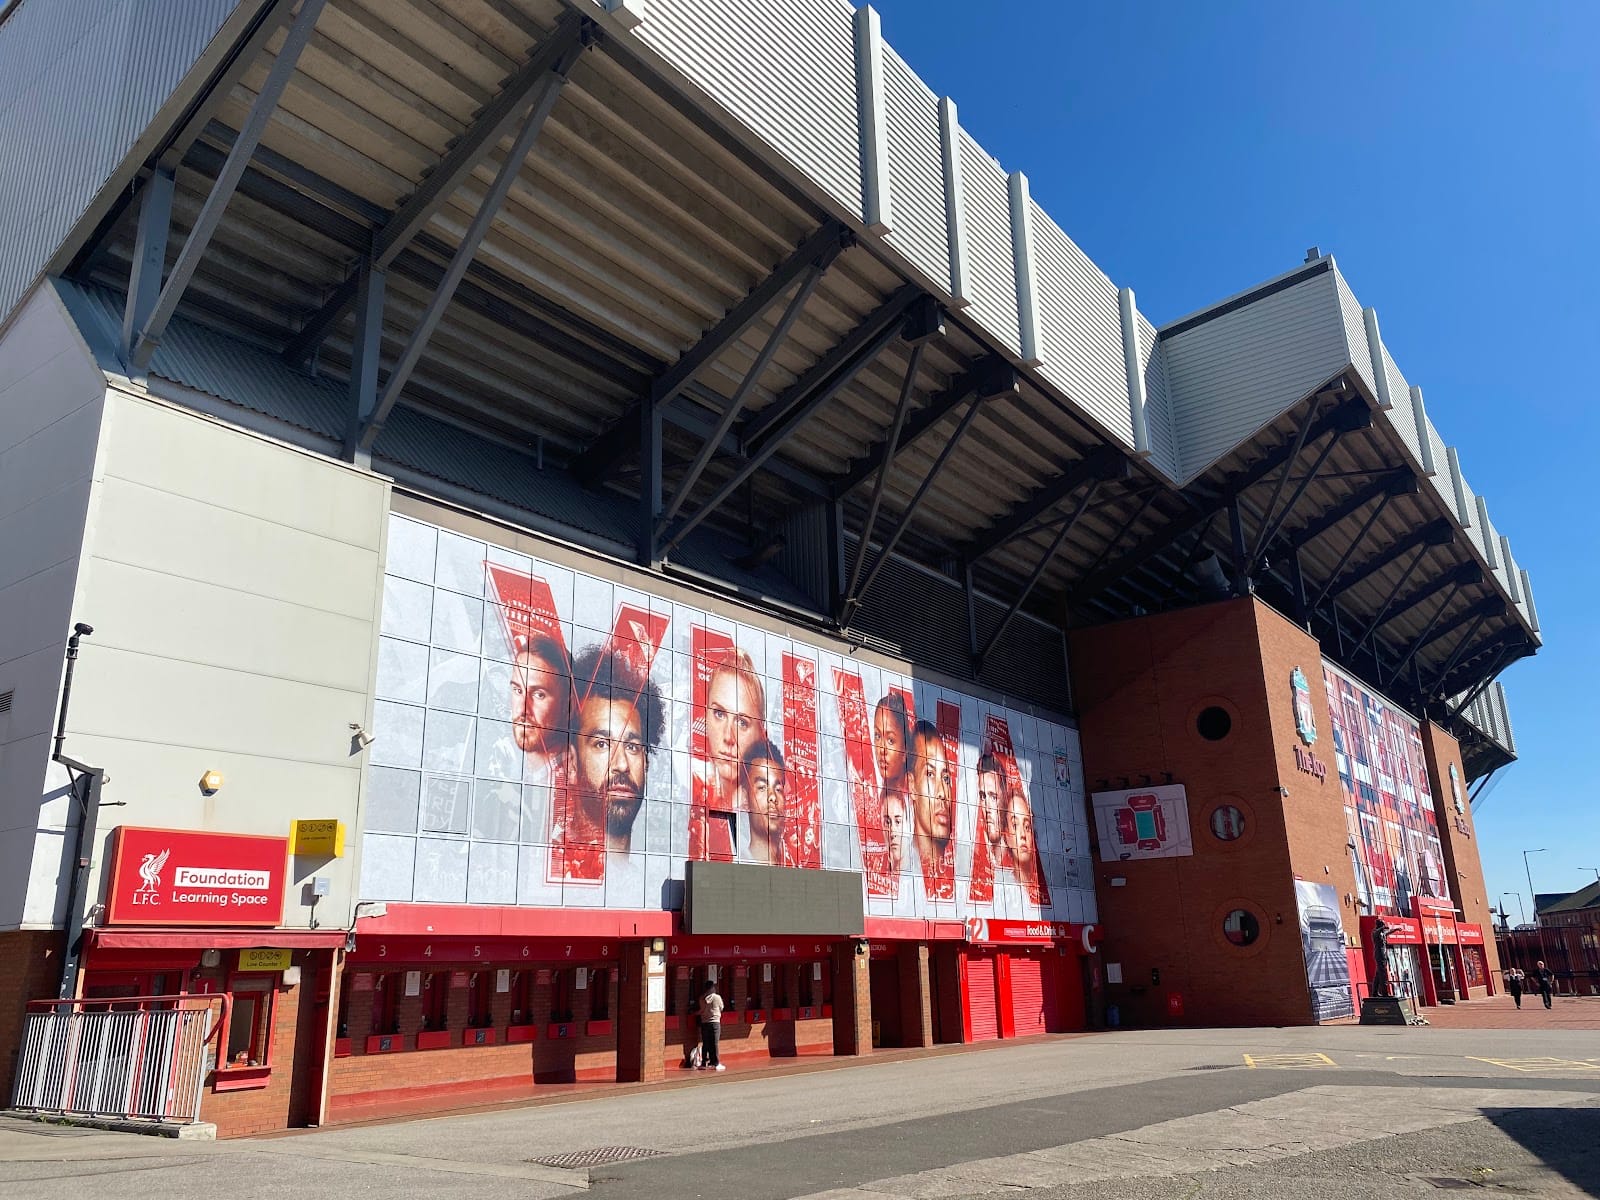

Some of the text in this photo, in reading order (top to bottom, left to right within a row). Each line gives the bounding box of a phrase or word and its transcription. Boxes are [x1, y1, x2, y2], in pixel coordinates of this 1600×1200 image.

[180, 871, 265, 886] Foundation
[172, 891, 268, 906] Learning Space
[1082, 925, 1096, 953] C
[379, 945, 386, 957] 3
[424, 945, 432, 957] 4
[474, 945, 481, 957] 5
[522, 945, 529, 957] 6
[565, 945, 572, 957] 7
[601, 945, 608, 956] 8
[671, 945, 678, 954] 10
[704, 945, 710, 955] 11
[733, 945, 740, 954] 12
[761, 944, 767, 954] 13
[789, 944, 795, 954] 14
[815, 944, 820, 953] 15
